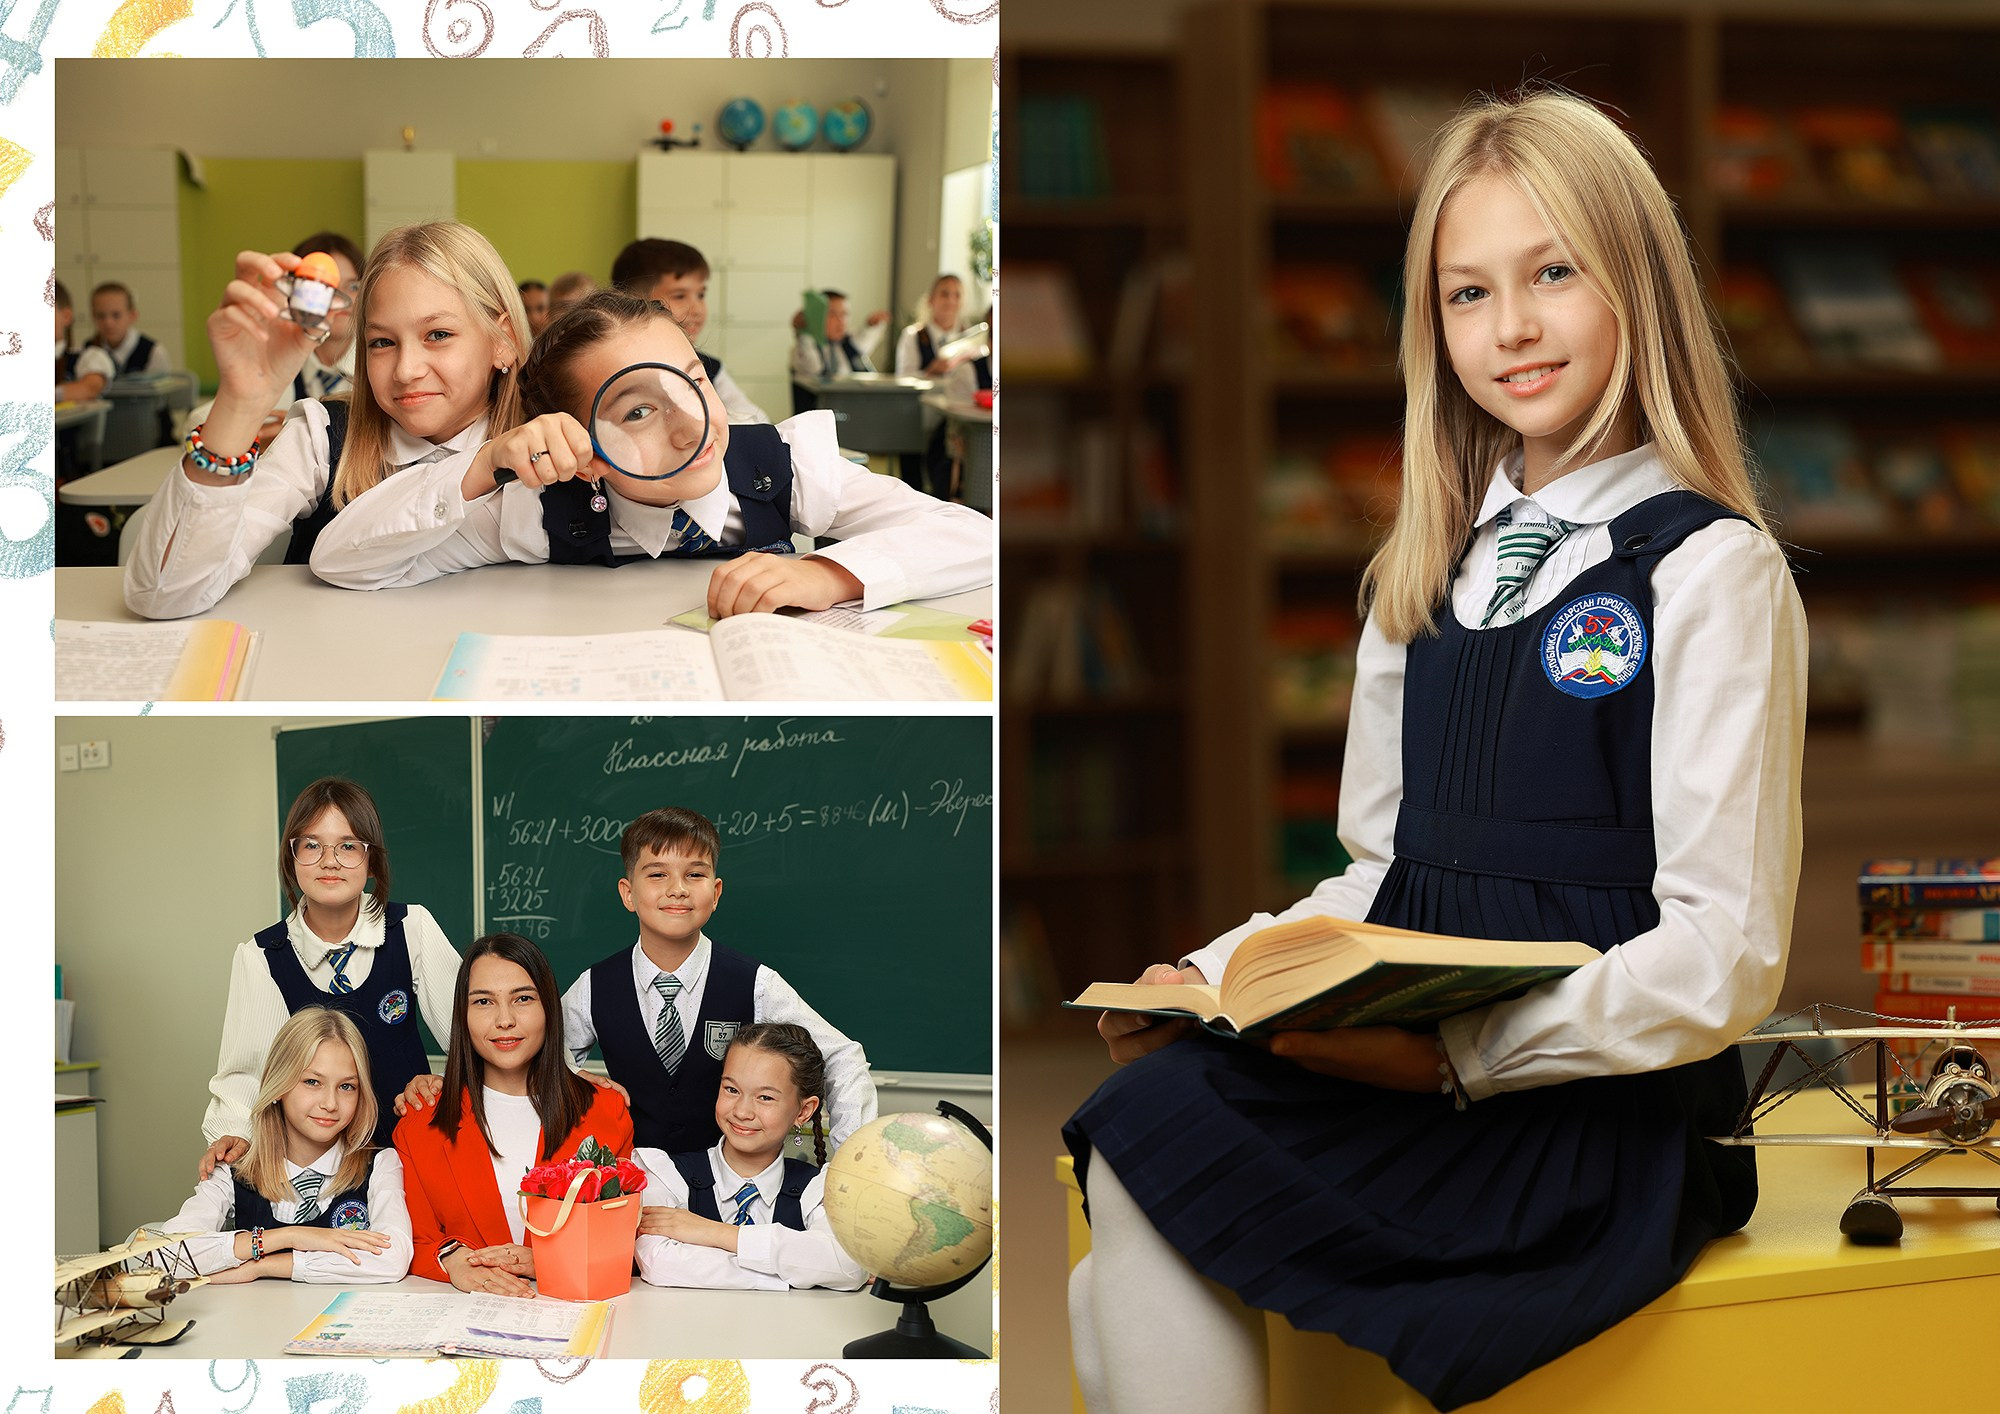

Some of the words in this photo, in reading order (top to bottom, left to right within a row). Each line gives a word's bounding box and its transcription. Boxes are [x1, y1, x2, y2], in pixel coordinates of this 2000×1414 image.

[1552, 598, 1595, 631] ТАТАРСТАН
[1596, 597, 1624, 612] ГОРОД
[1584, 615, 1615, 635] 57
[1620, 604, 1643, 661] НАБЕРЕЖНЫЕ
[1546, 632, 1563, 683] РЕСПУБЛИКА
[1567, 634, 1624, 656] ГИМНАЗИЯ
[1615, 660, 1638, 686] ЧЕЛНЫ
[602, 737, 730, 775] Классная
[730, 717, 847, 778] работа
[498, 862, 545, 888] 5621
[498, 887, 550, 913] 3225
[718, 1032, 728, 1040] 57
